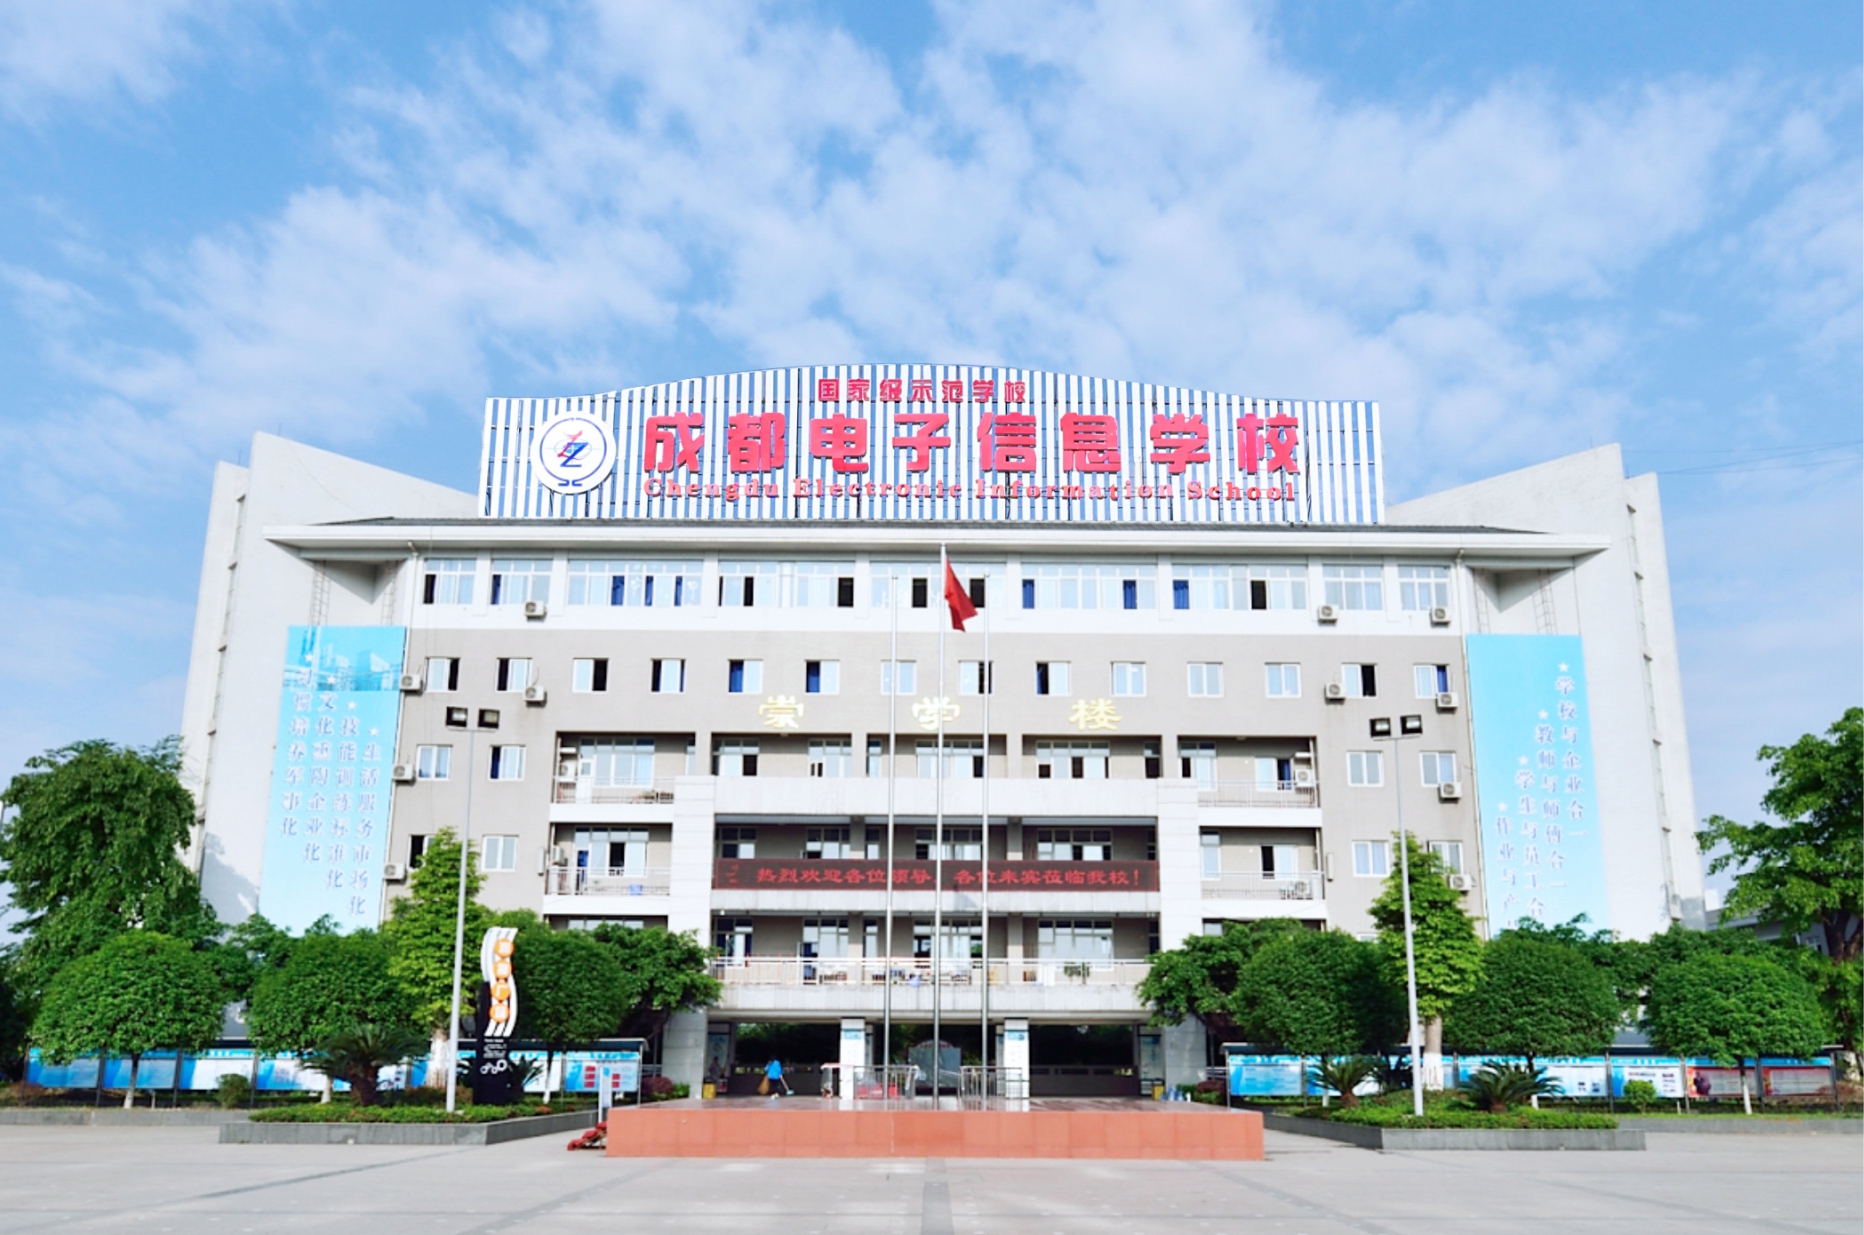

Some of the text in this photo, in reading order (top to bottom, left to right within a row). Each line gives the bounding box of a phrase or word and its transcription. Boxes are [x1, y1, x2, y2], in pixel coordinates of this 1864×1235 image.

[818, 378, 1026, 403] 国家级示范学校
[643, 412, 1301, 474] 成都电子信息学校
[643, 477, 1295, 502] Chengdu Electronic Information School
[758, 695, 1122, 731] 崇学楼
[1555, 676, 1588, 836] 学校与企业合一
[347, 742, 382, 916] 生活服务市场化
